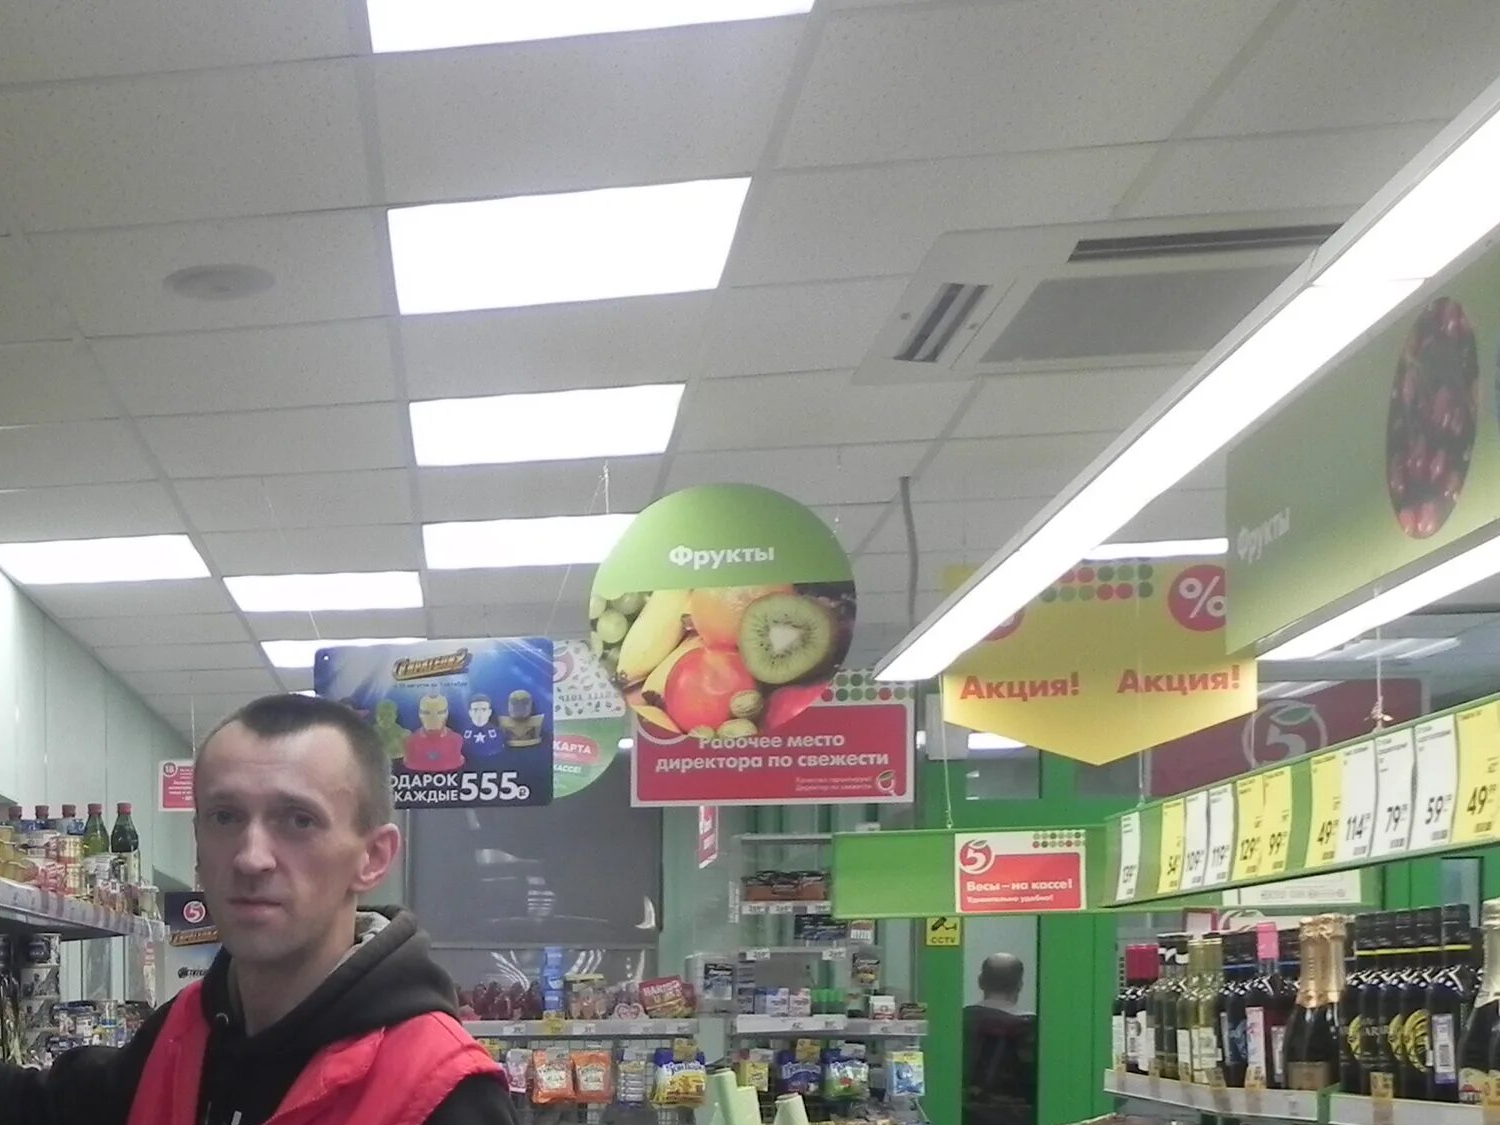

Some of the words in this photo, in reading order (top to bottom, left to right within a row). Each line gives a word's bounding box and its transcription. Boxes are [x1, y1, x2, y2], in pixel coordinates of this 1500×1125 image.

[1238, 508, 1290, 565] Фрукты
[669, 545, 775, 570] Фрукты
[961, 671, 1080, 701] Акция!
[1117, 664, 1241, 696] Акция!
[699, 736, 781, 750] Рабочее
[786, 733, 845, 748] место
[655, 758, 762, 778] директора
[768, 757, 792, 768] по
[797, 752, 889, 767] свежести
[394, 789, 459, 805] КАЖДЫЕ
[966, 880, 1001, 892] Весы
[1011, 882, 1029, 890] на
[1031, 877, 1073, 890] кассе!
[931, 934, 956, 944] CCTV
